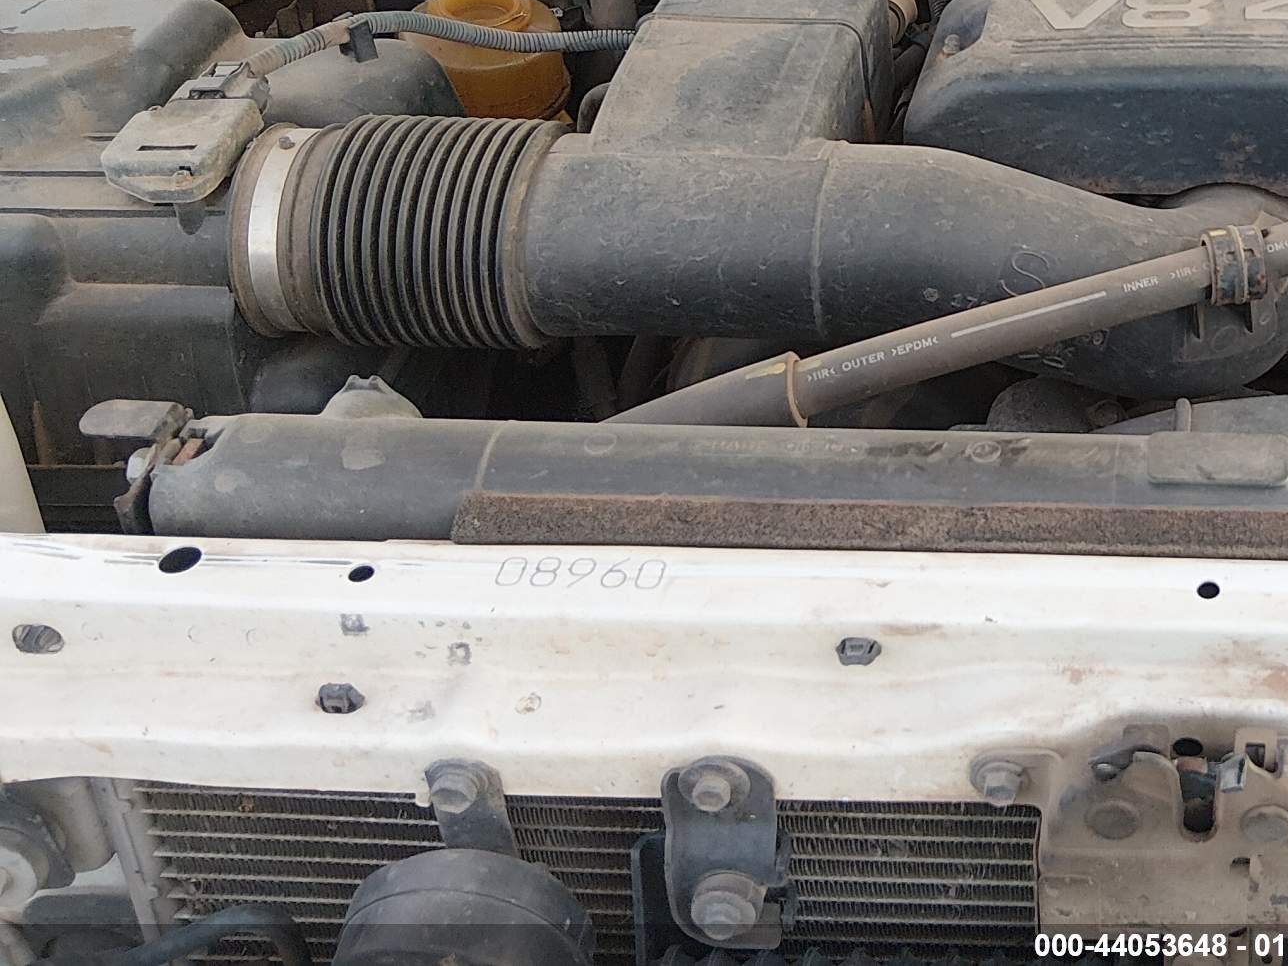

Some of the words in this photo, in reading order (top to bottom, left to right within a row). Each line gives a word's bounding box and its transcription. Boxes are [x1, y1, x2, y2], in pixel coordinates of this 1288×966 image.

[1122, 275, 1160, 293] INNER
[841, 350, 886, 372] OUTER
[494, 556, 668, 590] 08960
